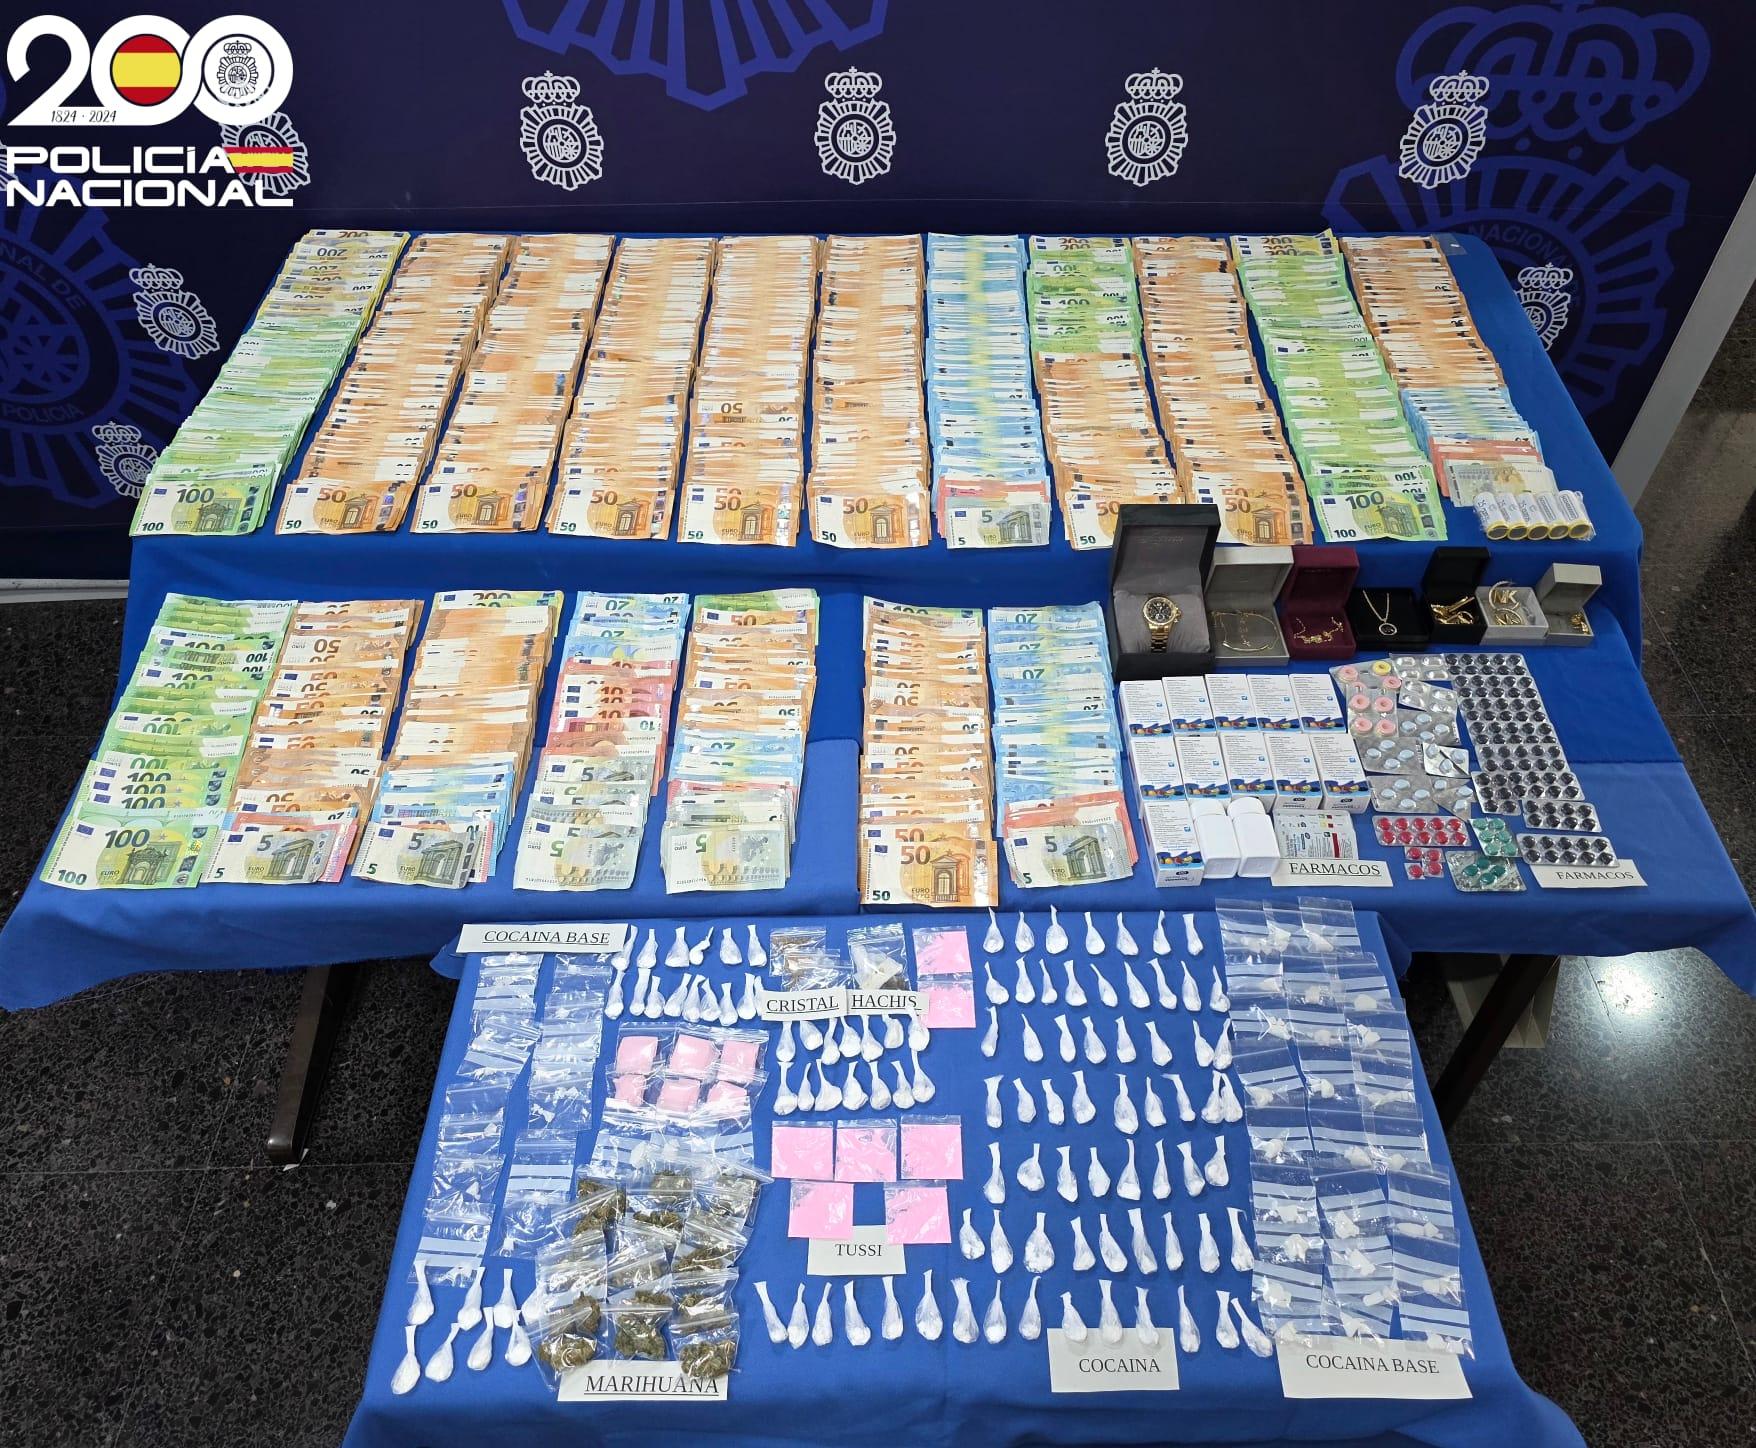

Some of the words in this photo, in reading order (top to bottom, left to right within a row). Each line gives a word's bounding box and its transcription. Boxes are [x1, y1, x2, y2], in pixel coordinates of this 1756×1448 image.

[176, 487, 214, 504] 100
[318, 487, 347, 504] 50
[451, 483, 478, 499] 50
[591, 489, 618, 506] 50
[714, 495, 741, 512] 50
[842, 498, 869, 515] 50
[1225, 496, 1251, 514] 50
[1345, 490, 1385, 510] 100
[982, 509, 993, 523] 5
[1097, 501, 1120, 517] 50
[142, 521, 164, 532] 100
[285, 519, 302, 529] 50
[422, 519, 438, 529] 50
[560, 521, 576, 532] 50
[688, 530, 704, 540] 50
[821, 531, 837, 543] 50
[958, 536, 966, 546] 5
[1080, 535, 1096, 545] 50
[1334, 528, 1356, 539] 100
[313, 638, 341, 654] 50
[580, 767, 594, 781] 5
[104, 829, 150, 849] 100
[257, 834, 273, 851] 5
[408, 832, 425, 850] 5
[695, 834, 707, 853] 5
[1044, 835, 1058, 853] 5
[550, 840, 564, 857] 5
[900, 845, 931, 865] 50
[215, 867, 225, 878] 5
[366, 863, 378, 874] 5
[1289, 862, 1381, 876] FARMACOS
[1555, 871, 1634, 881] FARMACOS
[58, 869, 87, 885] 100
[1023, 872, 1033, 884] 5
[872, 889, 891, 901] 50
[484, 930, 562, 943] COCAINA
[566, 931, 611, 944] BASE
[766, 995, 839, 1012] CRISTAL
[852, 994, 917, 1008] HACHIS
[835, 1243, 882, 1257] TUSSI
[1078, 1357, 1161, 1374] COCAINA
[1305, 1353, 1390, 1373] COCAINA
[1391, 1357, 1440, 1375] BASE
[584, 1375, 720, 1393] MARIHUANA
